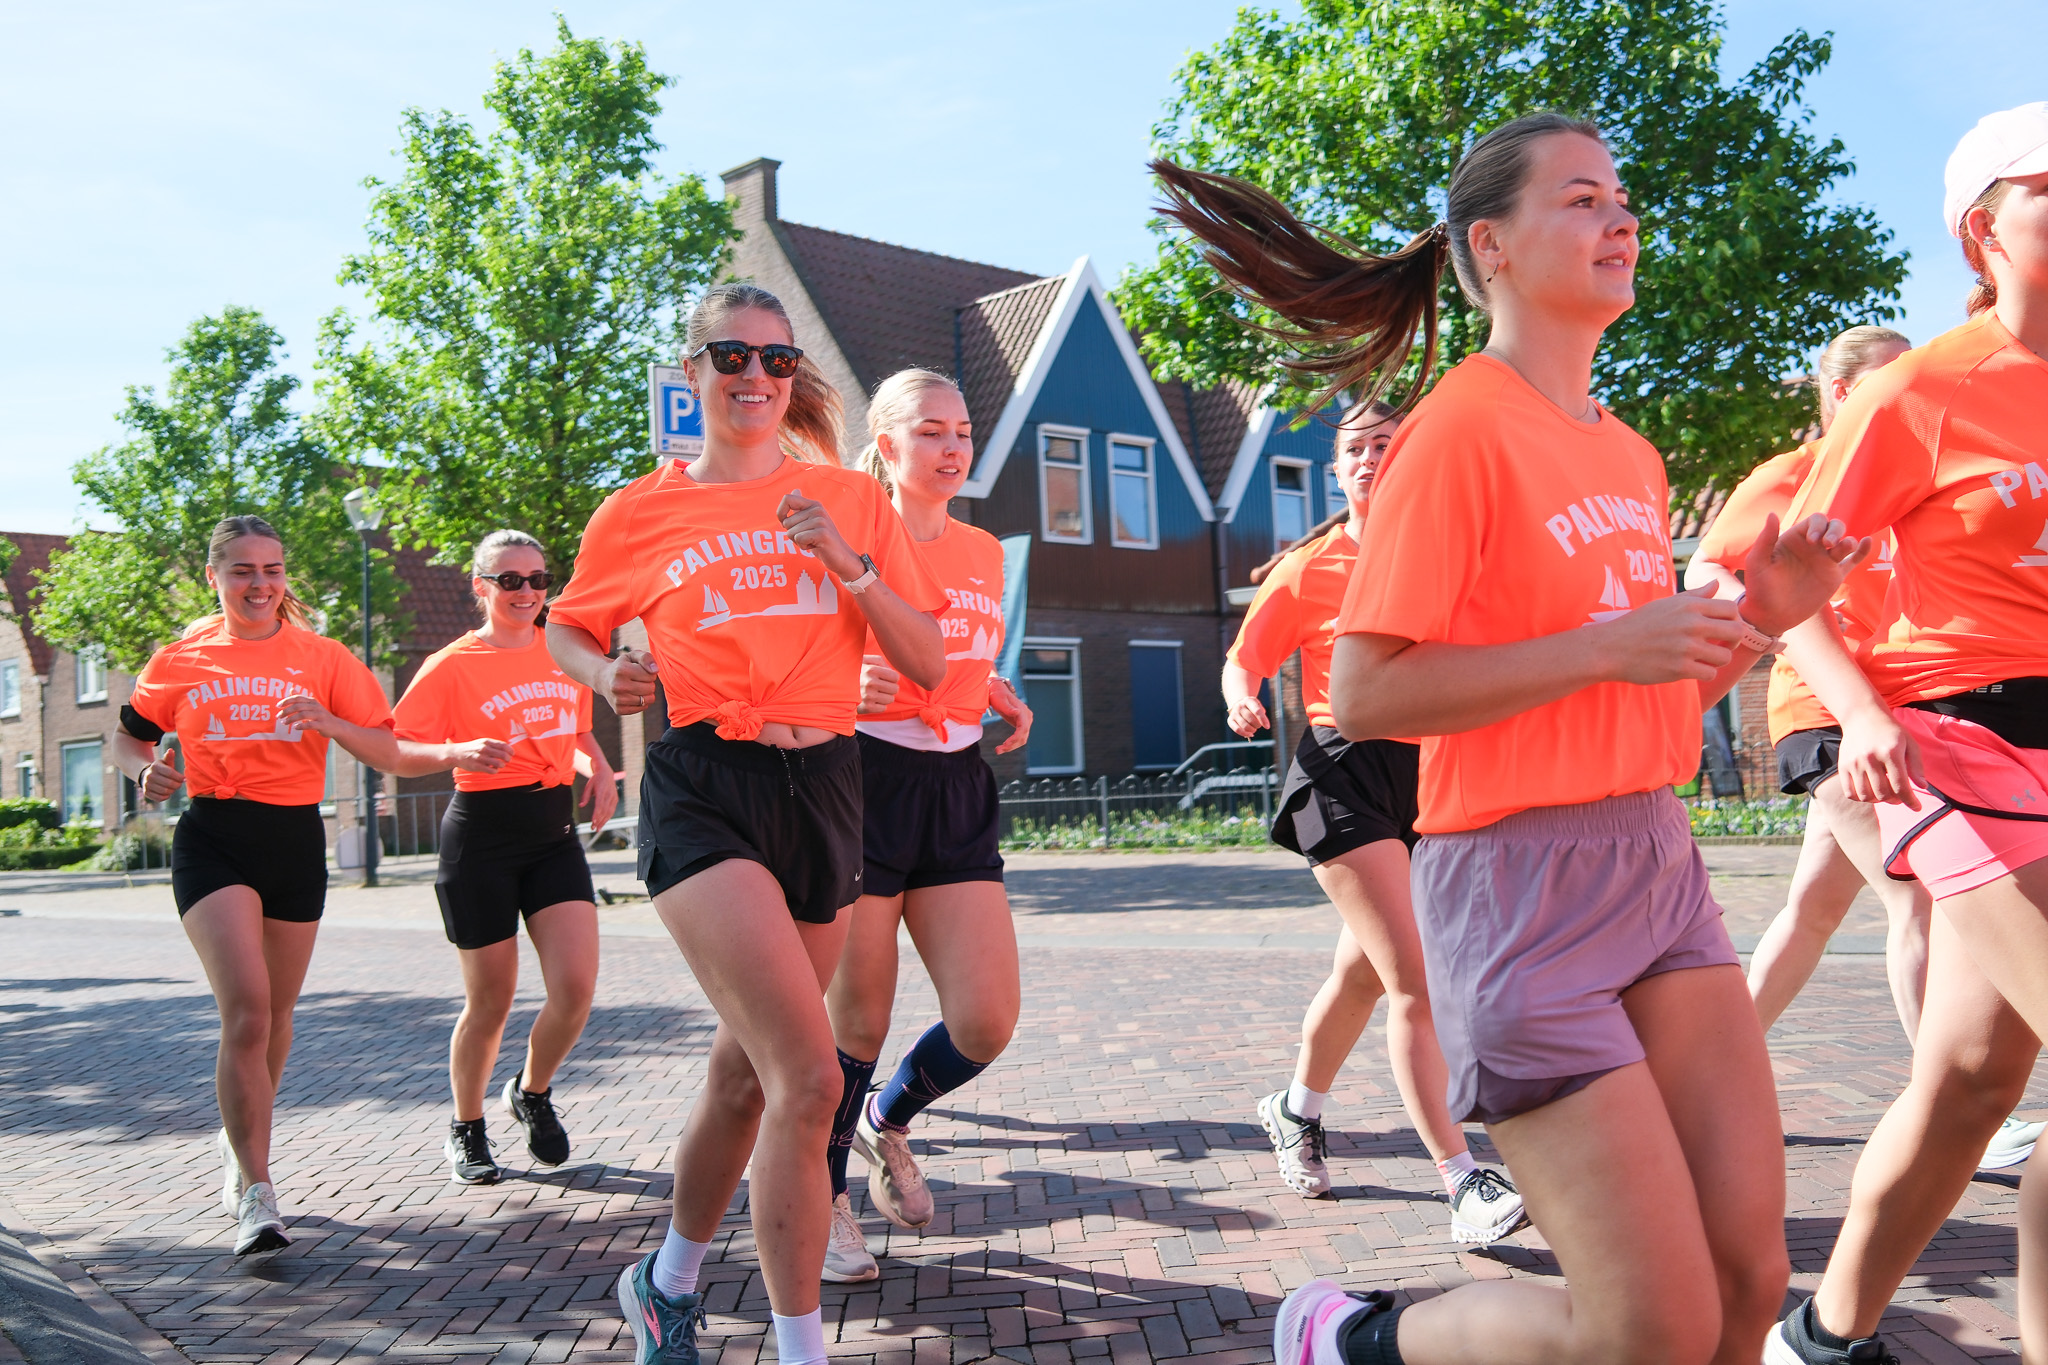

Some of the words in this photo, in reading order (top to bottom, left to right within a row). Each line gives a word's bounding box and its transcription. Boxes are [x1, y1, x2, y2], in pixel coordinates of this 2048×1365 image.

[669, 390, 696, 432] P
[1988, 461, 2048, 509] PA
[730, 564, 787, 591] 2025
[944, 588, 1001, 623] GRUN
[937, 618, 969, 638] 025
[229, 703, 271, 721] 2025
[480, 681, 578, 720] PALINGRUN
[522, 704, 554, 724] 2025
[1296, 1314, 1308, 1343] BROOKS
